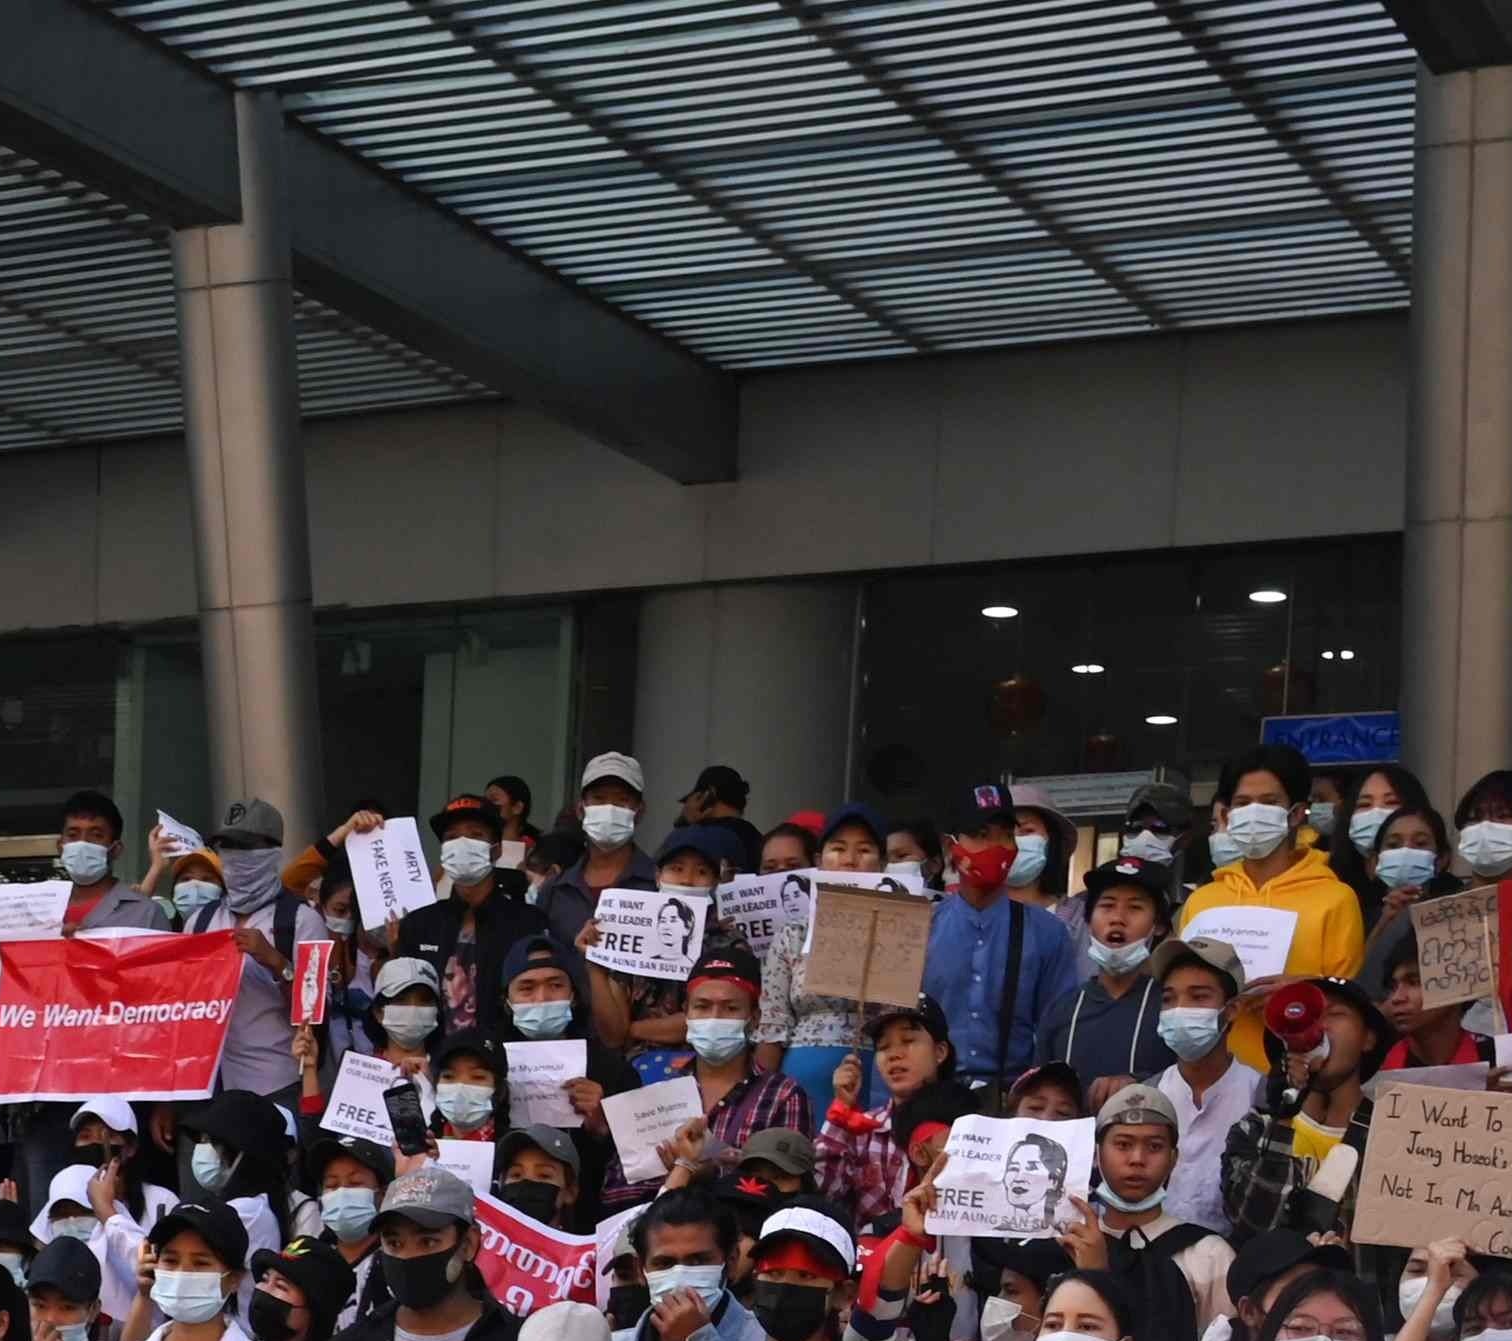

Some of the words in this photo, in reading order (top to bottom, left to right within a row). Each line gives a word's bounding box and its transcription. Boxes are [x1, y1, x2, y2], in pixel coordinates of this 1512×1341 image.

[370, 839, 388, 868] FAKE
[404, 849, 422, 884] MRTV
[377, 872, 398, 908] NEWS
[740, 886, 765, 898] WANT
[619, 900, 644, 910] WANT
[742, 900, 776, 912] LEADER
[617, 914, 653, 927] LEADER
[1219, 927, 1270, 939] Myanmar
[0, 1004, 34, 1027] We
[43, 1003, 100, 1027] Want
[109, 997, 233, 1026] Democracy
[335, 1102, 377, 1125] FREE
[1387, 1093, 1402, 1118] I
[1421, 1100, 1468, 1129] Want
[1485, 1106, 1503, 1132] To
[962, 1134, 992, 1145] WANT
[1406, 1130, 1442, 1167] Jung
[961, 1150, 1001, 1162] LEADER
[935, 1188, 983, 1208] FREE
[1380, 1174, 1413, 1199] Not
[1426, 1182, 1443, 1206] In
[962, 1212, 998, 1225] AUNG
[999, 1215, 1030, 1228] SAN
